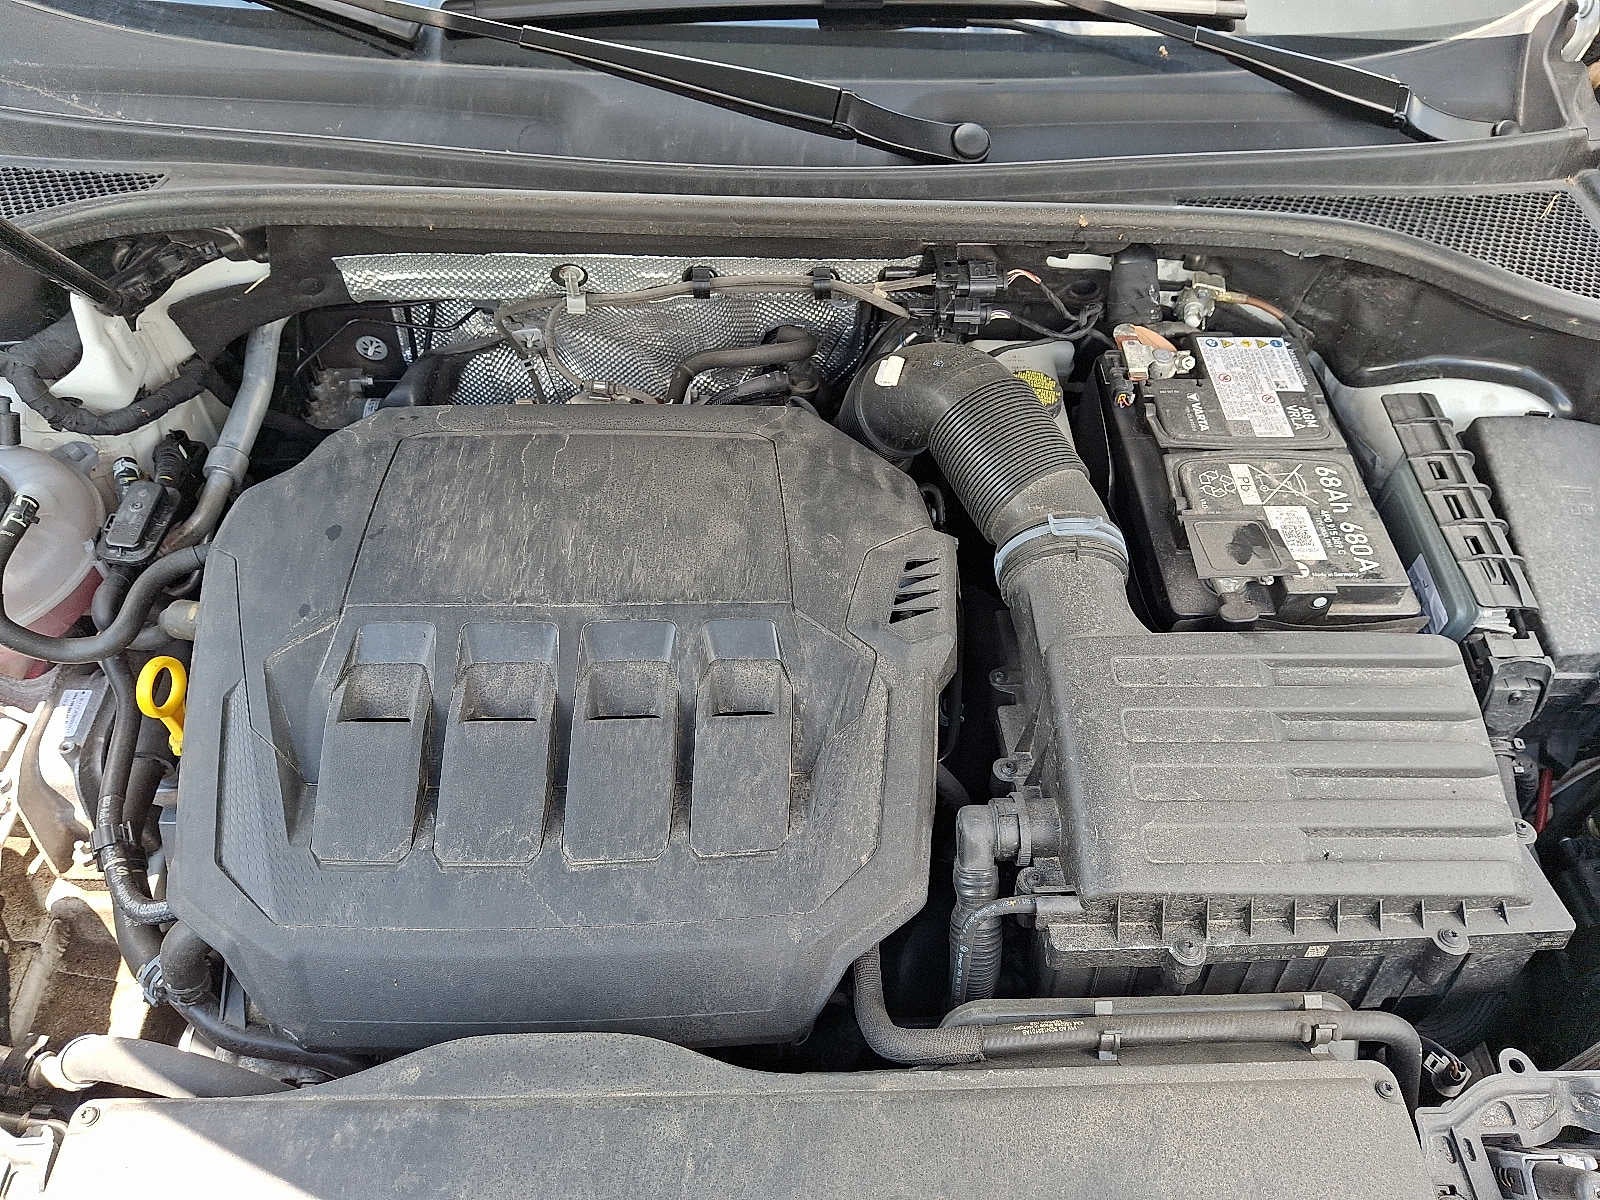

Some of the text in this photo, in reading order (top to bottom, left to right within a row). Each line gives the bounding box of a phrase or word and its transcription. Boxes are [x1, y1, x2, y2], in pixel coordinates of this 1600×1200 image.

[1191, 402, 1210, 431] VARTA
[1286, 405, 1306, 430] VRLA
[1298, 406, 1320, 428] AGM
[1238, 476, 1251, 491] Pb
[1315, 466, 1380, 573] 68Ah 680A
